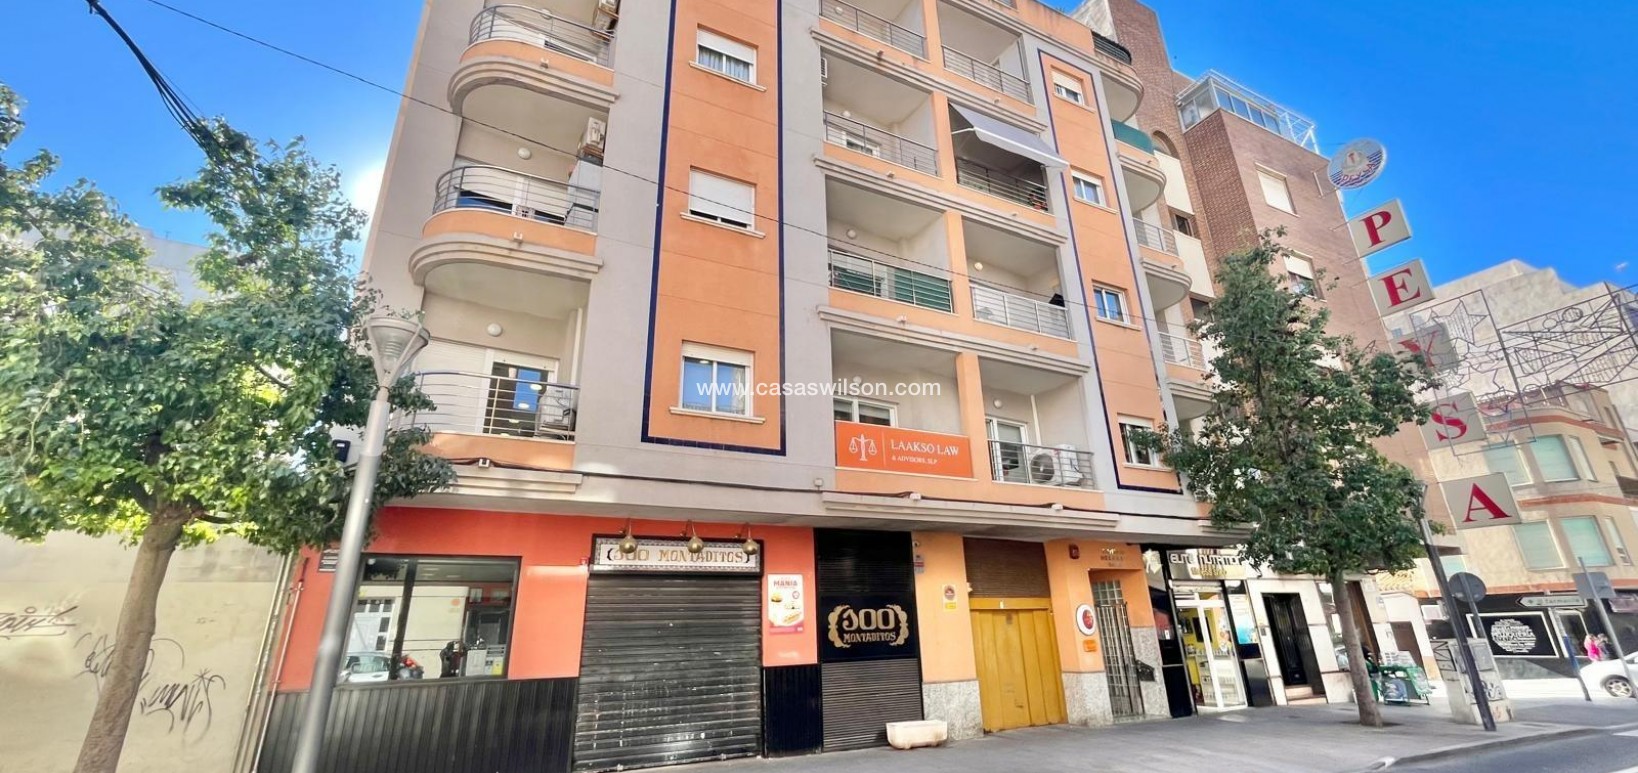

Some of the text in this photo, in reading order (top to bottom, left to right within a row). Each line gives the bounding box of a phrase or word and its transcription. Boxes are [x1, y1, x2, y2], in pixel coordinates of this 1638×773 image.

[890, 439, 959, 456] LAAKSO LAW
[658, 549, 743, 563] MONTADITOS
[843, 632, 897, 643] MONTADITOS
